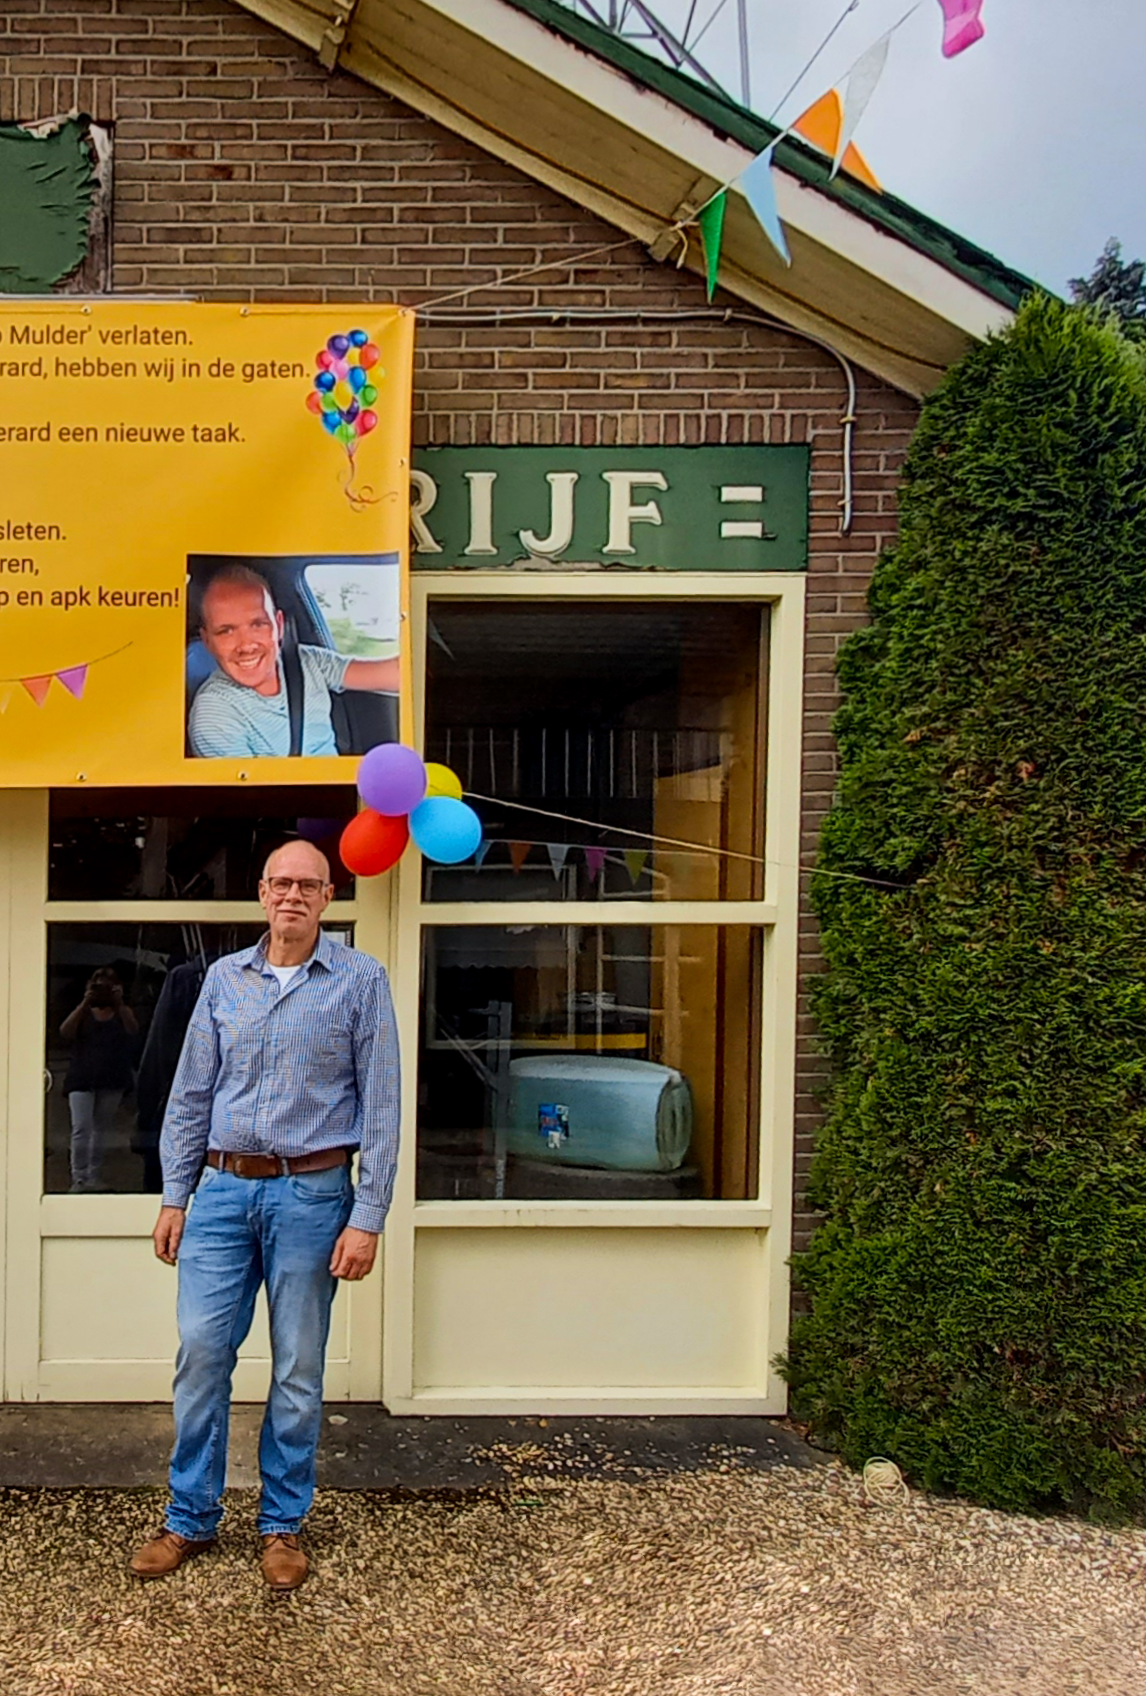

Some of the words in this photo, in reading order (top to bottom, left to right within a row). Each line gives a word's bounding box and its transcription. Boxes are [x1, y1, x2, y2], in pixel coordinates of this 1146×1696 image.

[9, 324, 92, 346] Mulder'
[98, 324, 194, 346] verlaten.
[54, 356, 137, 378] hebben
[143, 357, 175, 383] wij
[181, 357, 201, 378] in
[207, 356, 235, 379] de
[241, 359, 311, 384] gaten.
[57, 426, 99, 443] een
[105, 422, 186, 443] nieuwe
[190, 421, 246, 443] taak.
[16, 590, 44, 607] en
[50, 584, 92, 612] apk
[97, 585, 180, 608] keuren!
